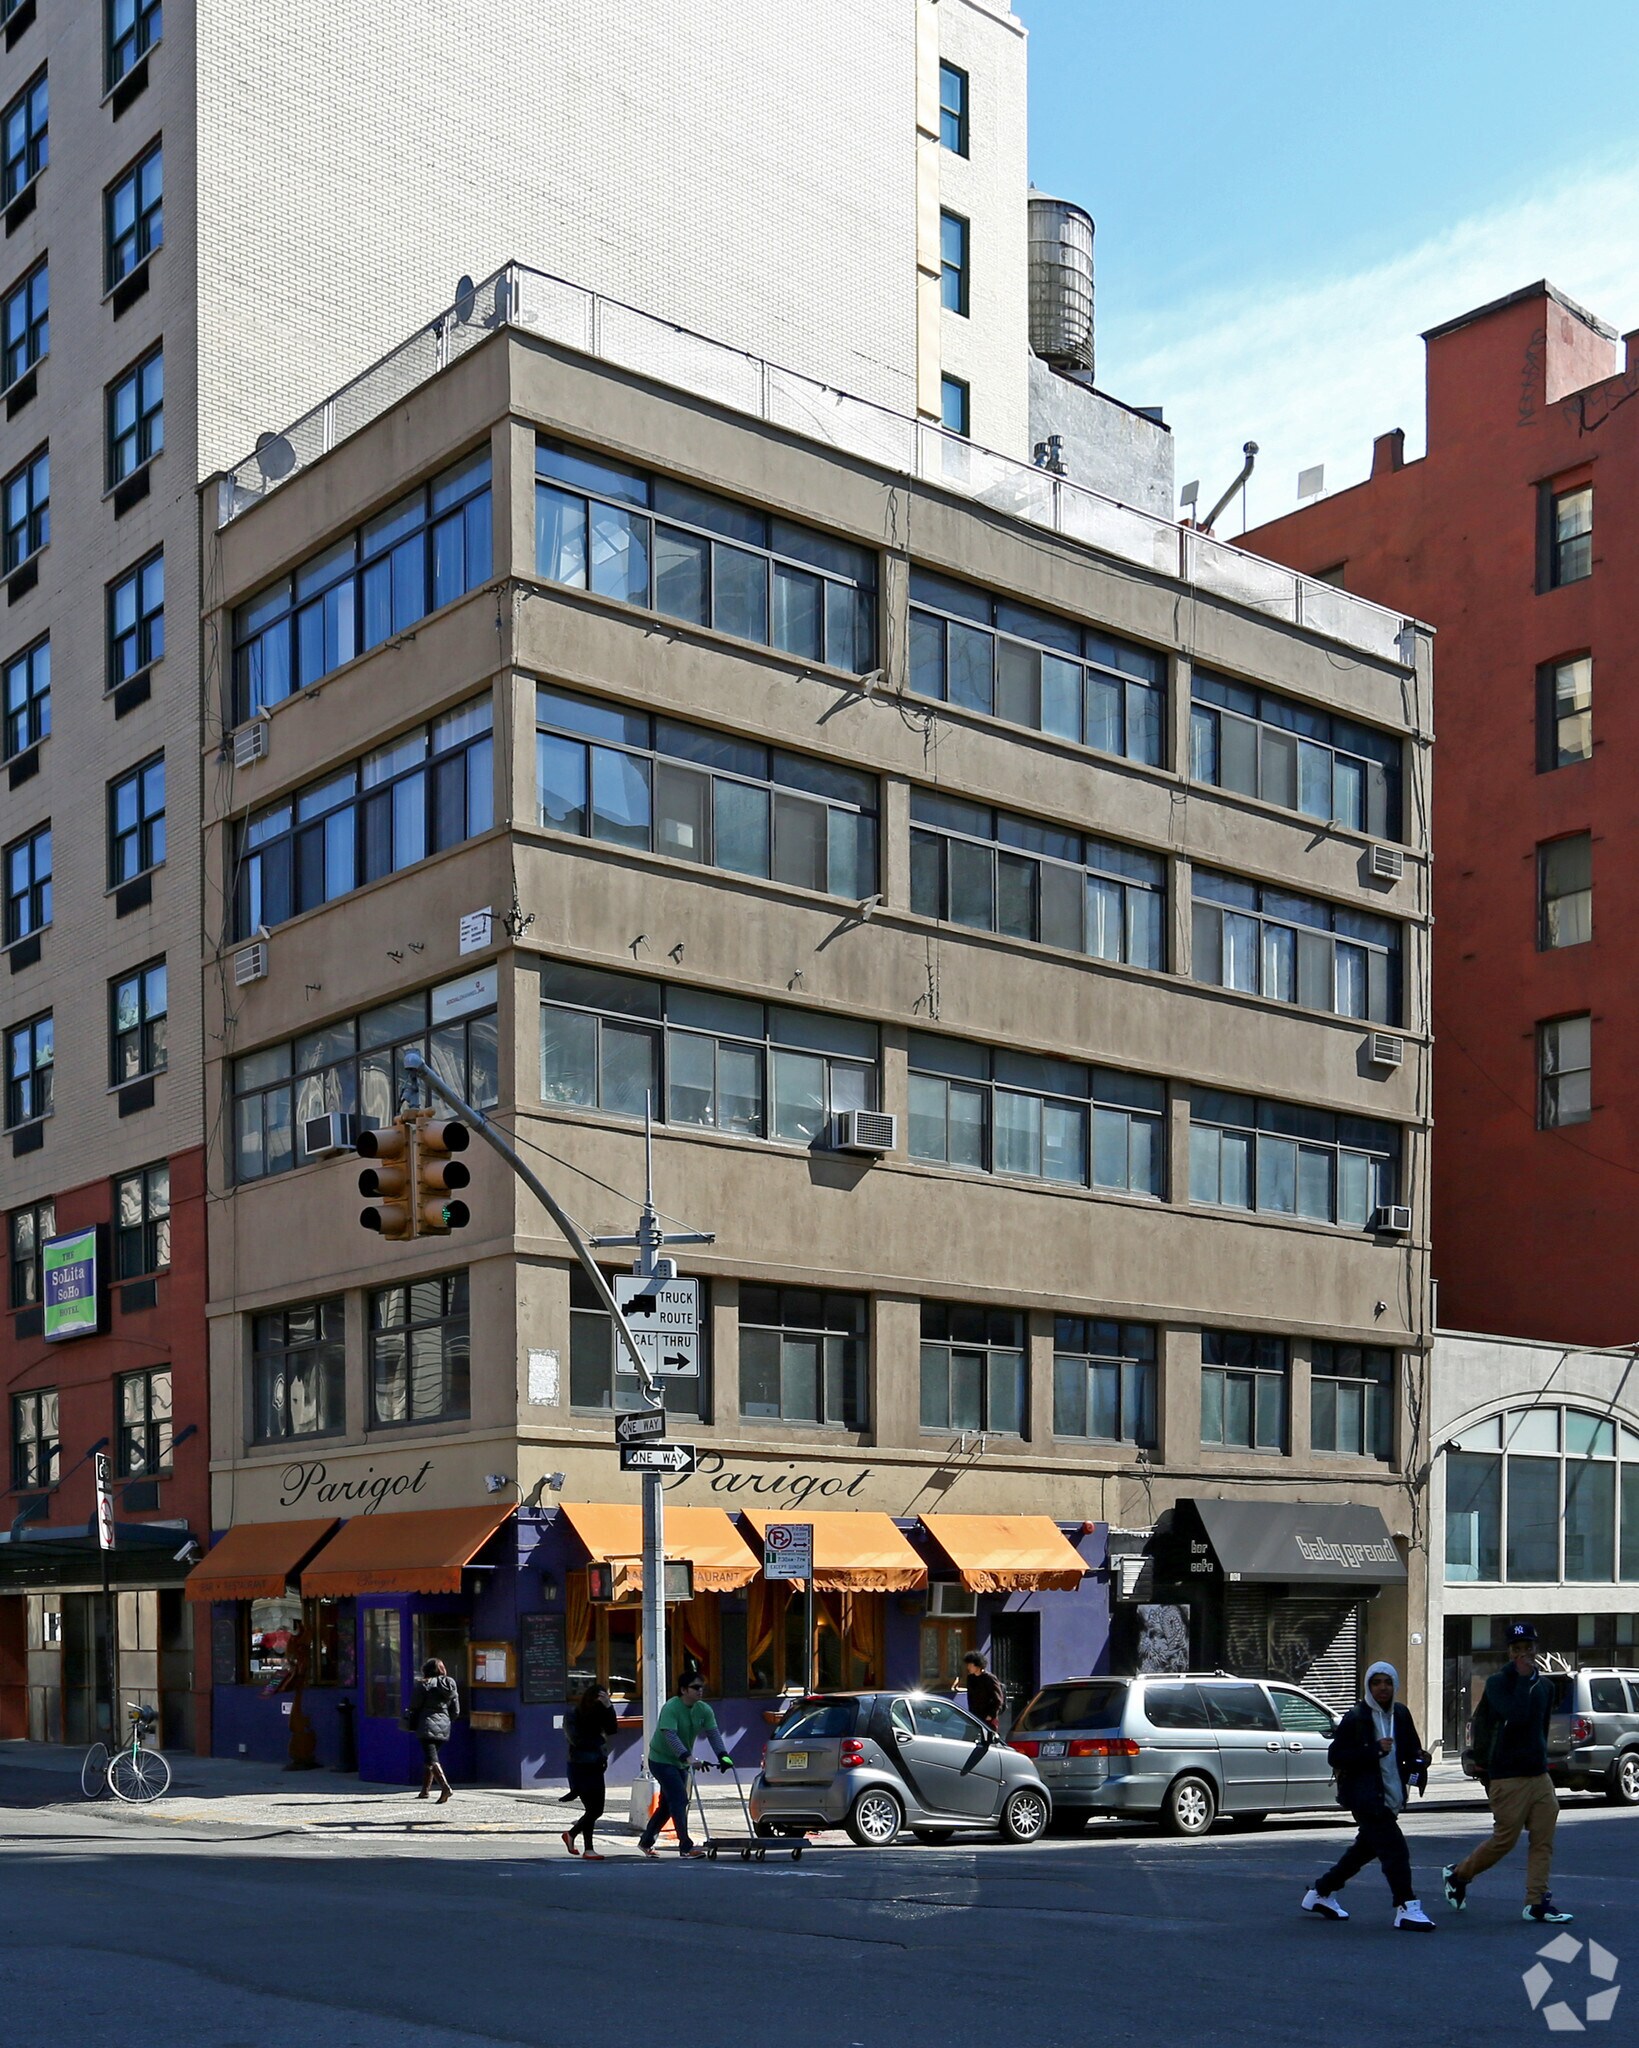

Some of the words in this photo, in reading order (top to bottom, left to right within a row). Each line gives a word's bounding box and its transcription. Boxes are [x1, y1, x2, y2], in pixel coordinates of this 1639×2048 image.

[62, 1251, 74, 1261] THE
[52, 1267, 85, 1285] SoLita
[58, 1286, 80, 1300] SoHo
[660, 1291, 693, 1304] TRUCK
[60, 1306, 79, 1317] HOTEL
[660, 1313, 693, 1324] ROUTE
[620, 1334, 653, 1346] LCAL
[664, 1336, 691, 1347] THRU
[622, 1422, 637, 1434] ONE
[643, 1419, 659, 1431] WAY
[631, 1451, 653, 1463] ONE
[662, 1453, 684, 1464] WAY
[280, 1461, 434, 1516] Parigot
[1191, 1540, 1208, 1553] bar
